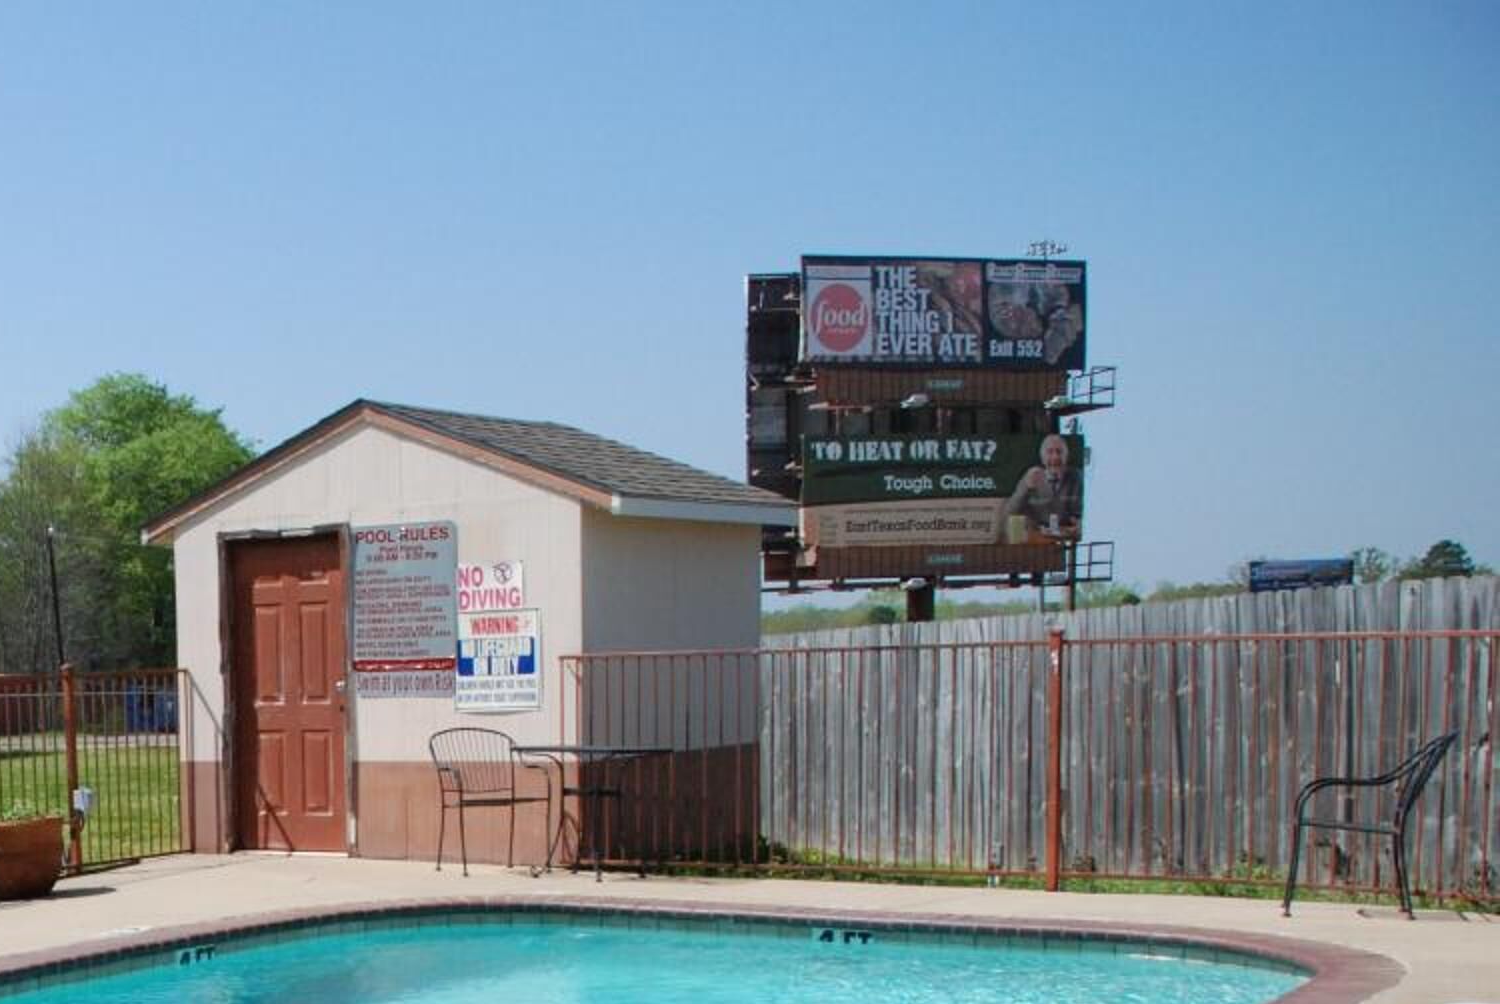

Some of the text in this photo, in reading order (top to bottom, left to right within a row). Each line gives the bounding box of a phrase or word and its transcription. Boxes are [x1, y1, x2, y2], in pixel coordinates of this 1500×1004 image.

[877, 265, 917, 288] THE
[876, 288, 931, 311] BEST
[814, 301, 865, 336] food
[877, 311, 940, 333] THING
[878, 333, 978, 355] EVER ATE
[990, 339, 1043, 357] Exit 552
[812, 442, 842, 461] TO
[849, 441, 904, 462] HEAT
[910, 440, 940, 461] OR
[883, 474, 997, 493] Tough Choice.
[356, 525, 450, 545] POOL RULES
[458, 566, 484, 588] NO
[459, 587, 521, 610] DIVING
